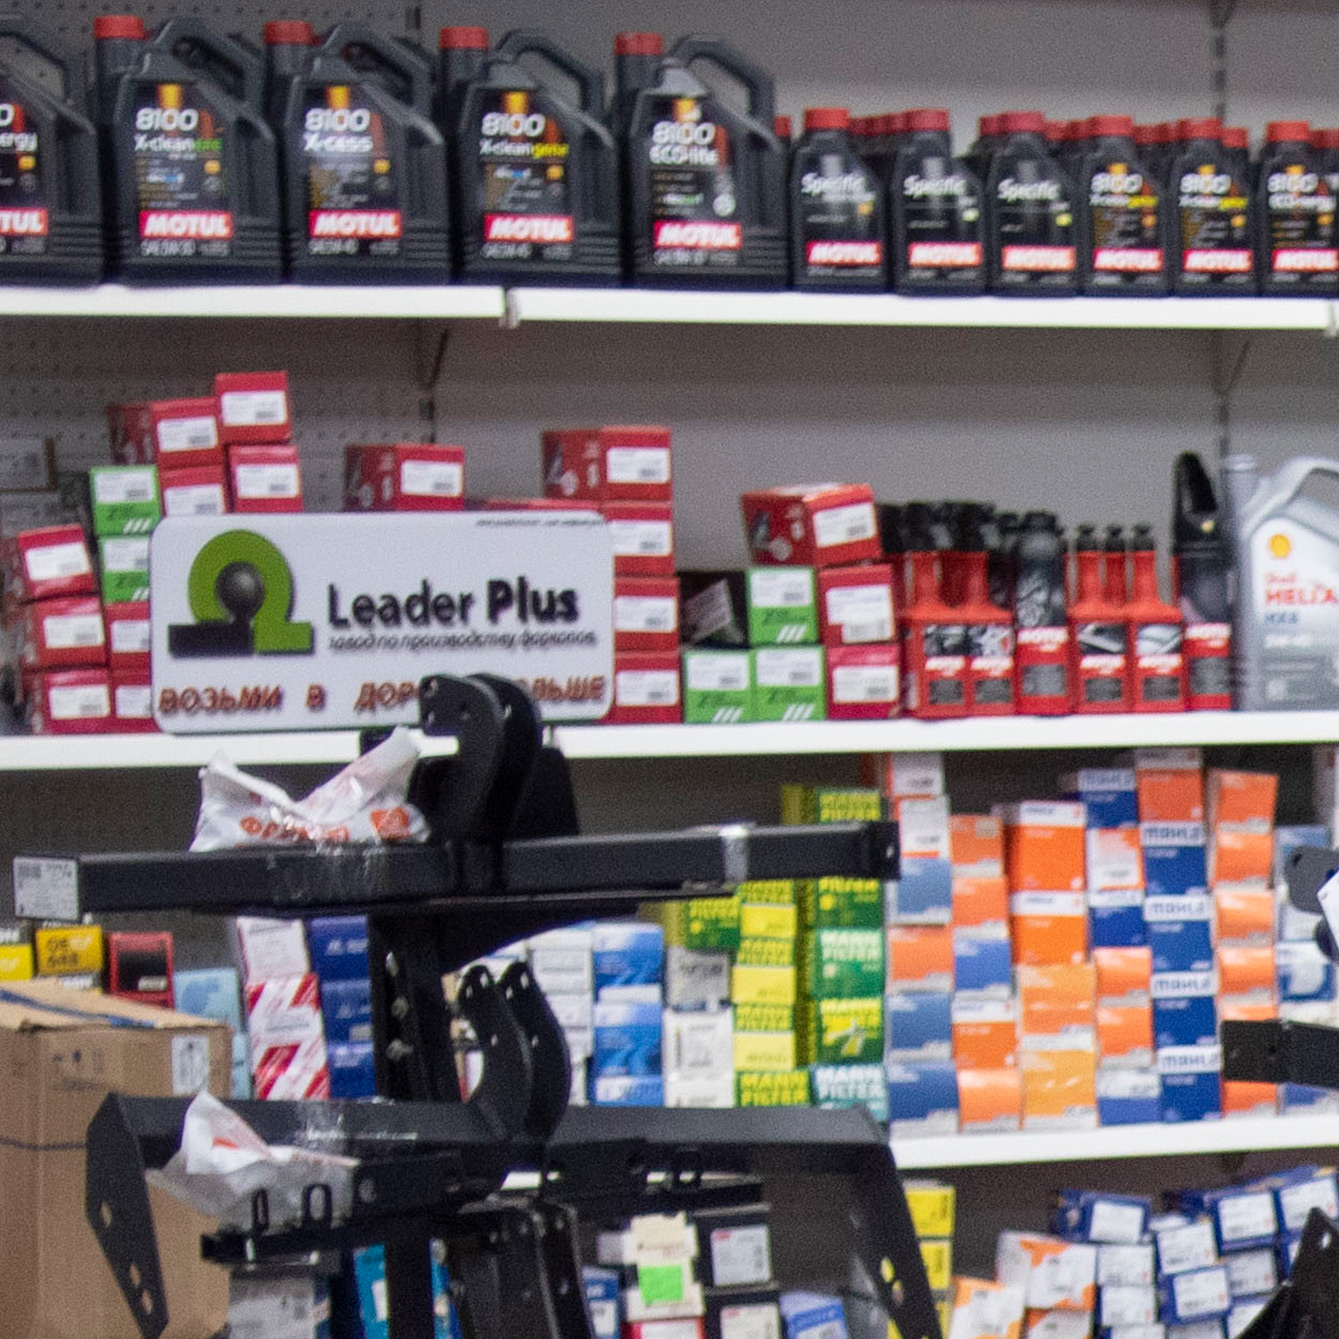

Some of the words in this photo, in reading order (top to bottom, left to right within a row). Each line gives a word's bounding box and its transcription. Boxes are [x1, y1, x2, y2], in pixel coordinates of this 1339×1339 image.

[136, 107, 199, 132] 8100
[304, 107, 370, 132] 8100
[481, 112, 547, 137] 8100
[652, 121, 716, 146] 8100
[0, 211, 44, 233] TUL
[144, 212, 230, 237] MOTUL
[314, 212, 400, 237] MOTUL
[488, 214, 572, 240] MOTUL
[656, 222, 739, 248] MOTUL
[328, 577, 475, 629] Leader
[486, 575, 580, 625] Plus
[158, 684, 283, 714] ВОЗЬМИ
[305, 684, 326, 708] В
